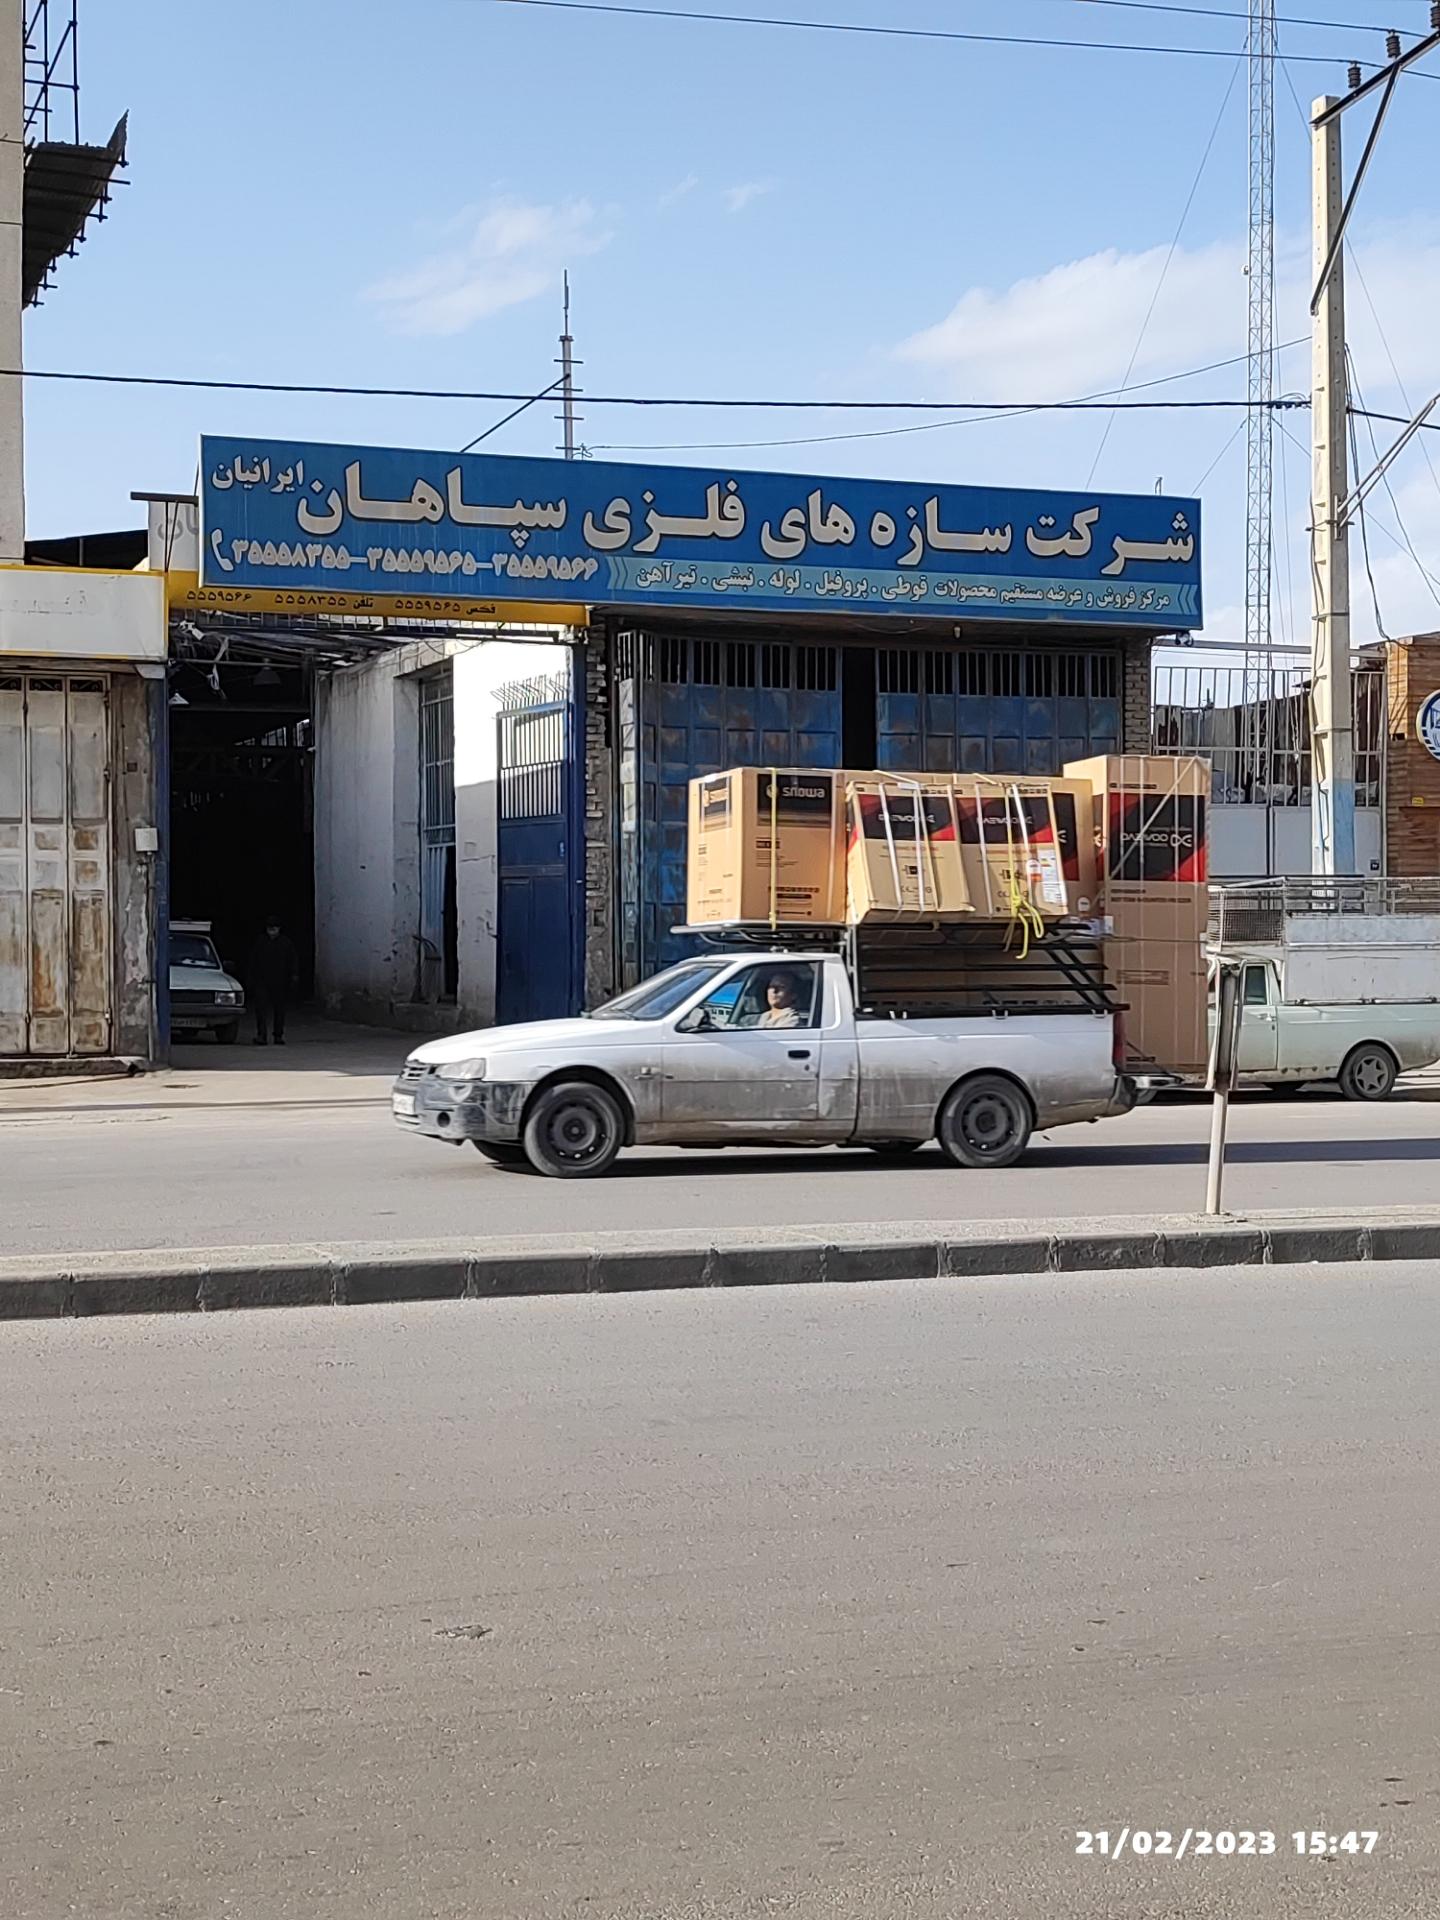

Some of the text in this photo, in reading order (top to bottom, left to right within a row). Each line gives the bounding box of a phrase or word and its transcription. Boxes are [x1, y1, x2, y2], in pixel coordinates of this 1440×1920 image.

[211, 455, 1194, 576] شرکت سازه های فلزی سپاهان ایرانیان
[711, 566, 754, 592] نبشی
[768, 568, 800, 594] لوله
[815, 570, 868, 599] پروفیل
[881, 575, 928, 601] قوطی
[933, 578, 998, 602] محصولات
[352, 595, 373, 610] تلفن
[1000, 582, 1043, 604] مستقیم
[1046, 584, 1083, 607] عرضه
[1085, 592, 1094, 608] و
[1096, 586, 1136, 609] فروش
[1139, 588, 1170, 611] مرکز
[466, 603, 496, 615] فکس
